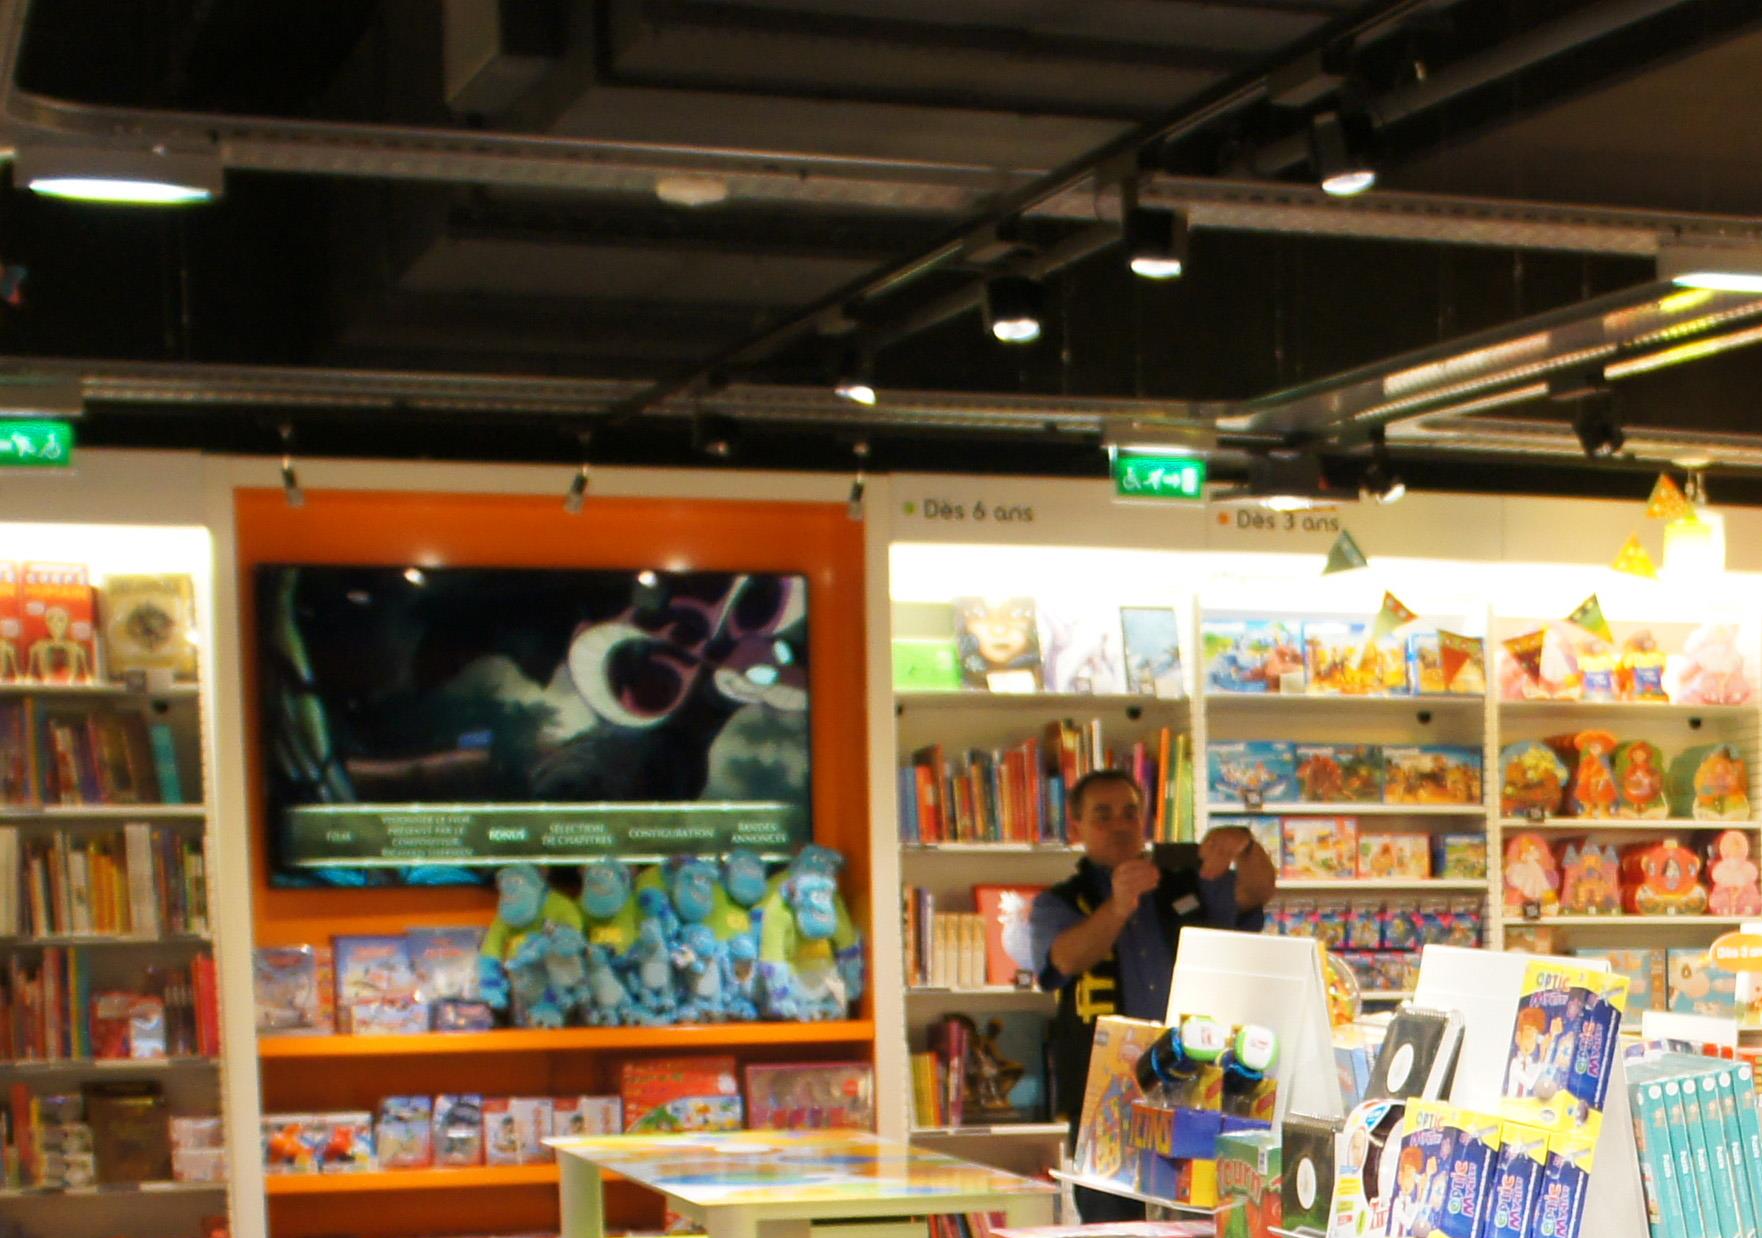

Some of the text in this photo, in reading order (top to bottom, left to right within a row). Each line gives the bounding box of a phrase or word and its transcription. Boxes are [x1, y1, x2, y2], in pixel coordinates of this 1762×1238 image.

[924, 500, 1034, 523] Dès 6 ans
[1237, 510, 1340, 533] Dès 3 ans
